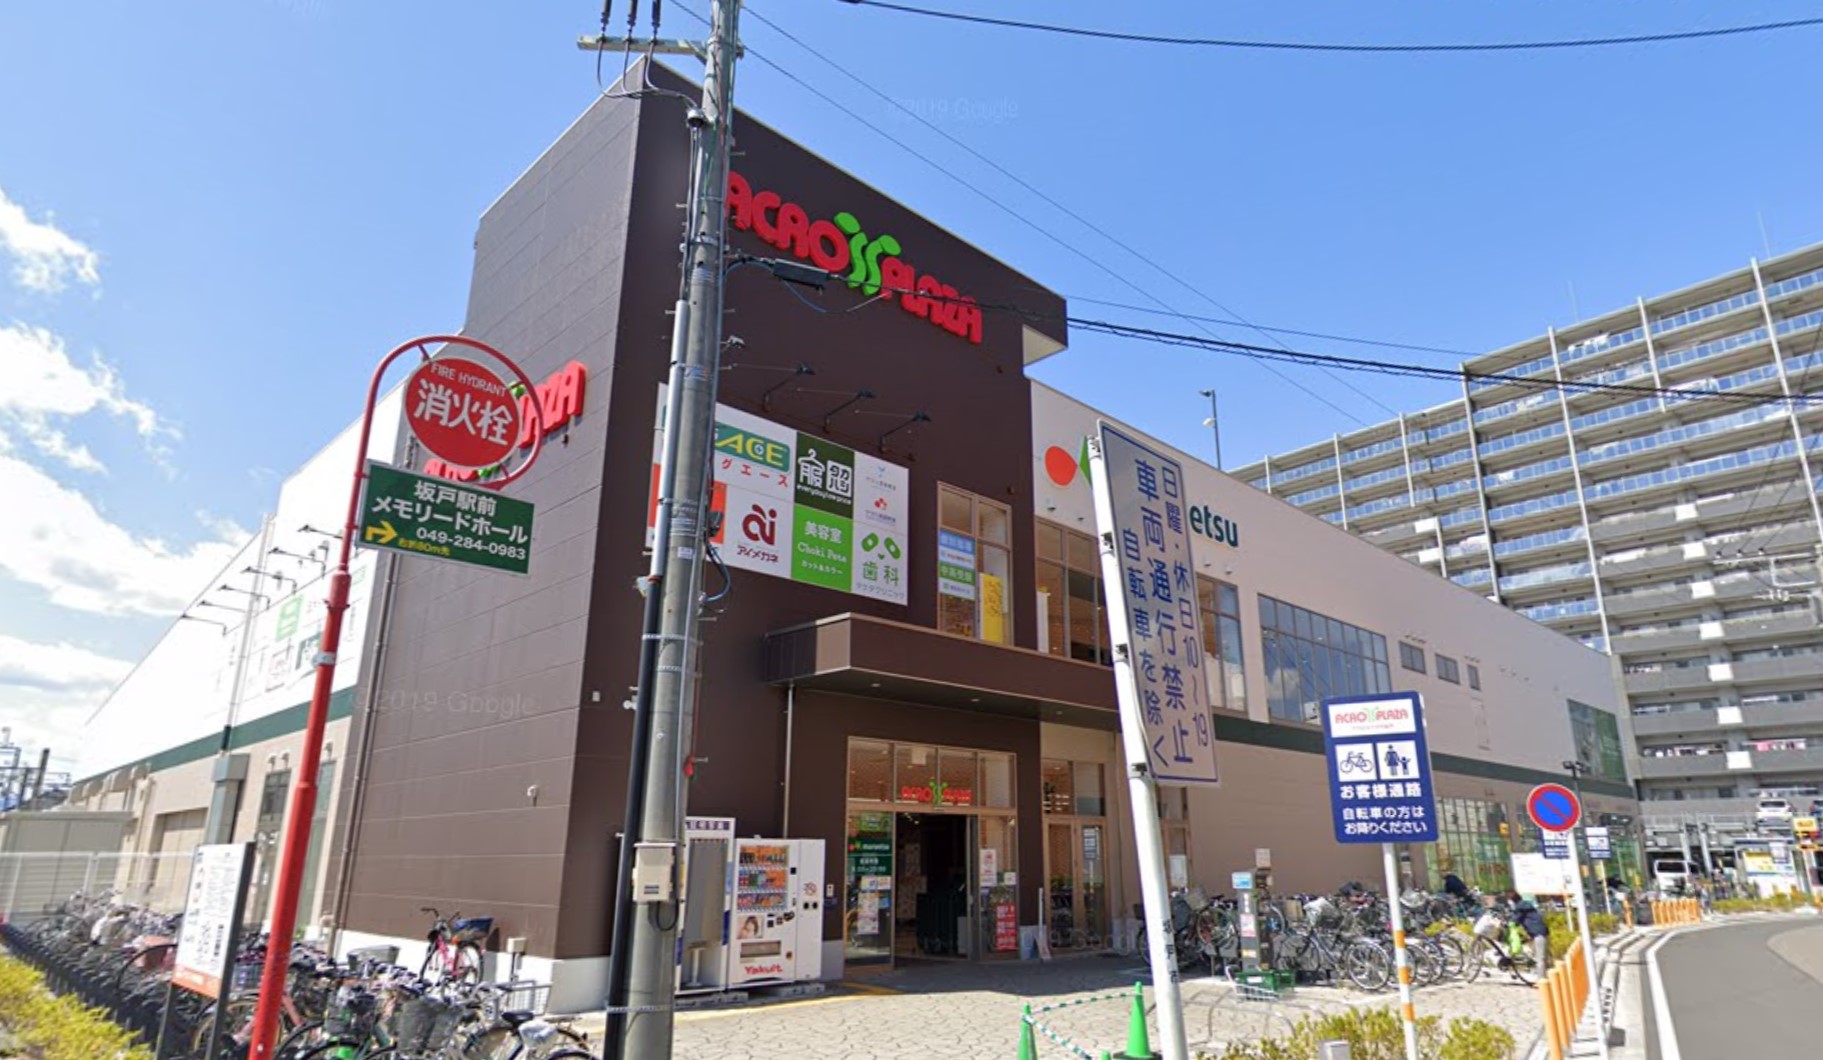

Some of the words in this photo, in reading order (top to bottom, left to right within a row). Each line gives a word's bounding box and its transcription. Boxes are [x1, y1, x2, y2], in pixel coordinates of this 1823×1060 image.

[881, 257, 983, 344] PLAZA
[430, 363, 456, 380] FIRE
[458, 372, 507, 397] HYDRANT
[413, 378, 513, 446] 消火栓
[715, 433, 787, 467] ACE
[414, 479, 497, 517] 坂戸駅前
[371, 496, 528, 544] メモリードホール
[804, 520, 842, 545] 美容室
[416, 527, 526, 560] 049-284-0983
[737, 544, 779, 563] アイメガネ
[862, 560, 899, 587] 歯科
[1135, 458, 1193, 763] 車両通行禁止
[1123, 528, 1169, 767] 自転車を除く
[1375, 707, 1409, 721] PLAZA
[1340, 782, 1422, 799] お客様通路
[1342, 806, 1425, 820] 自転車の方は
[1344, 821, 1428, 835] お降りください
[744, 964, 784, 976] Yakult
